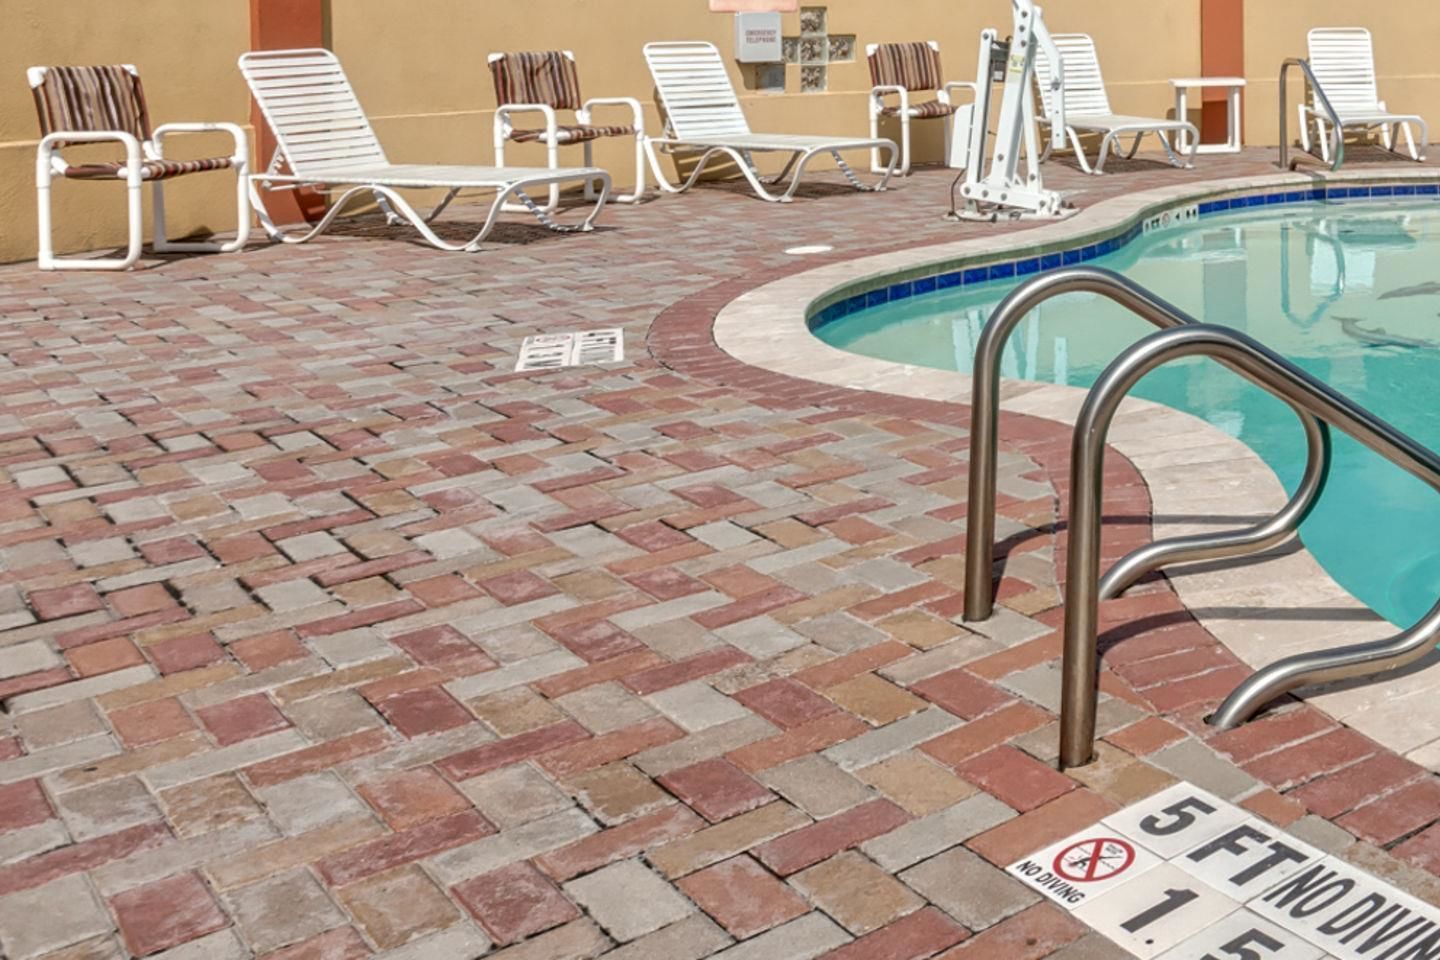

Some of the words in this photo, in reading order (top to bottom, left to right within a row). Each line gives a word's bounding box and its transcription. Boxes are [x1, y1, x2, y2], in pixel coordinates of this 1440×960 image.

[1016, 861, 1043, 876] NO
[1035, 872, 1086, 903] DIVING
[1139, 795, 1218, 836] 5
[1185, 824, 1310, 887] FT
[1262, 864, 1356, 919] NO
